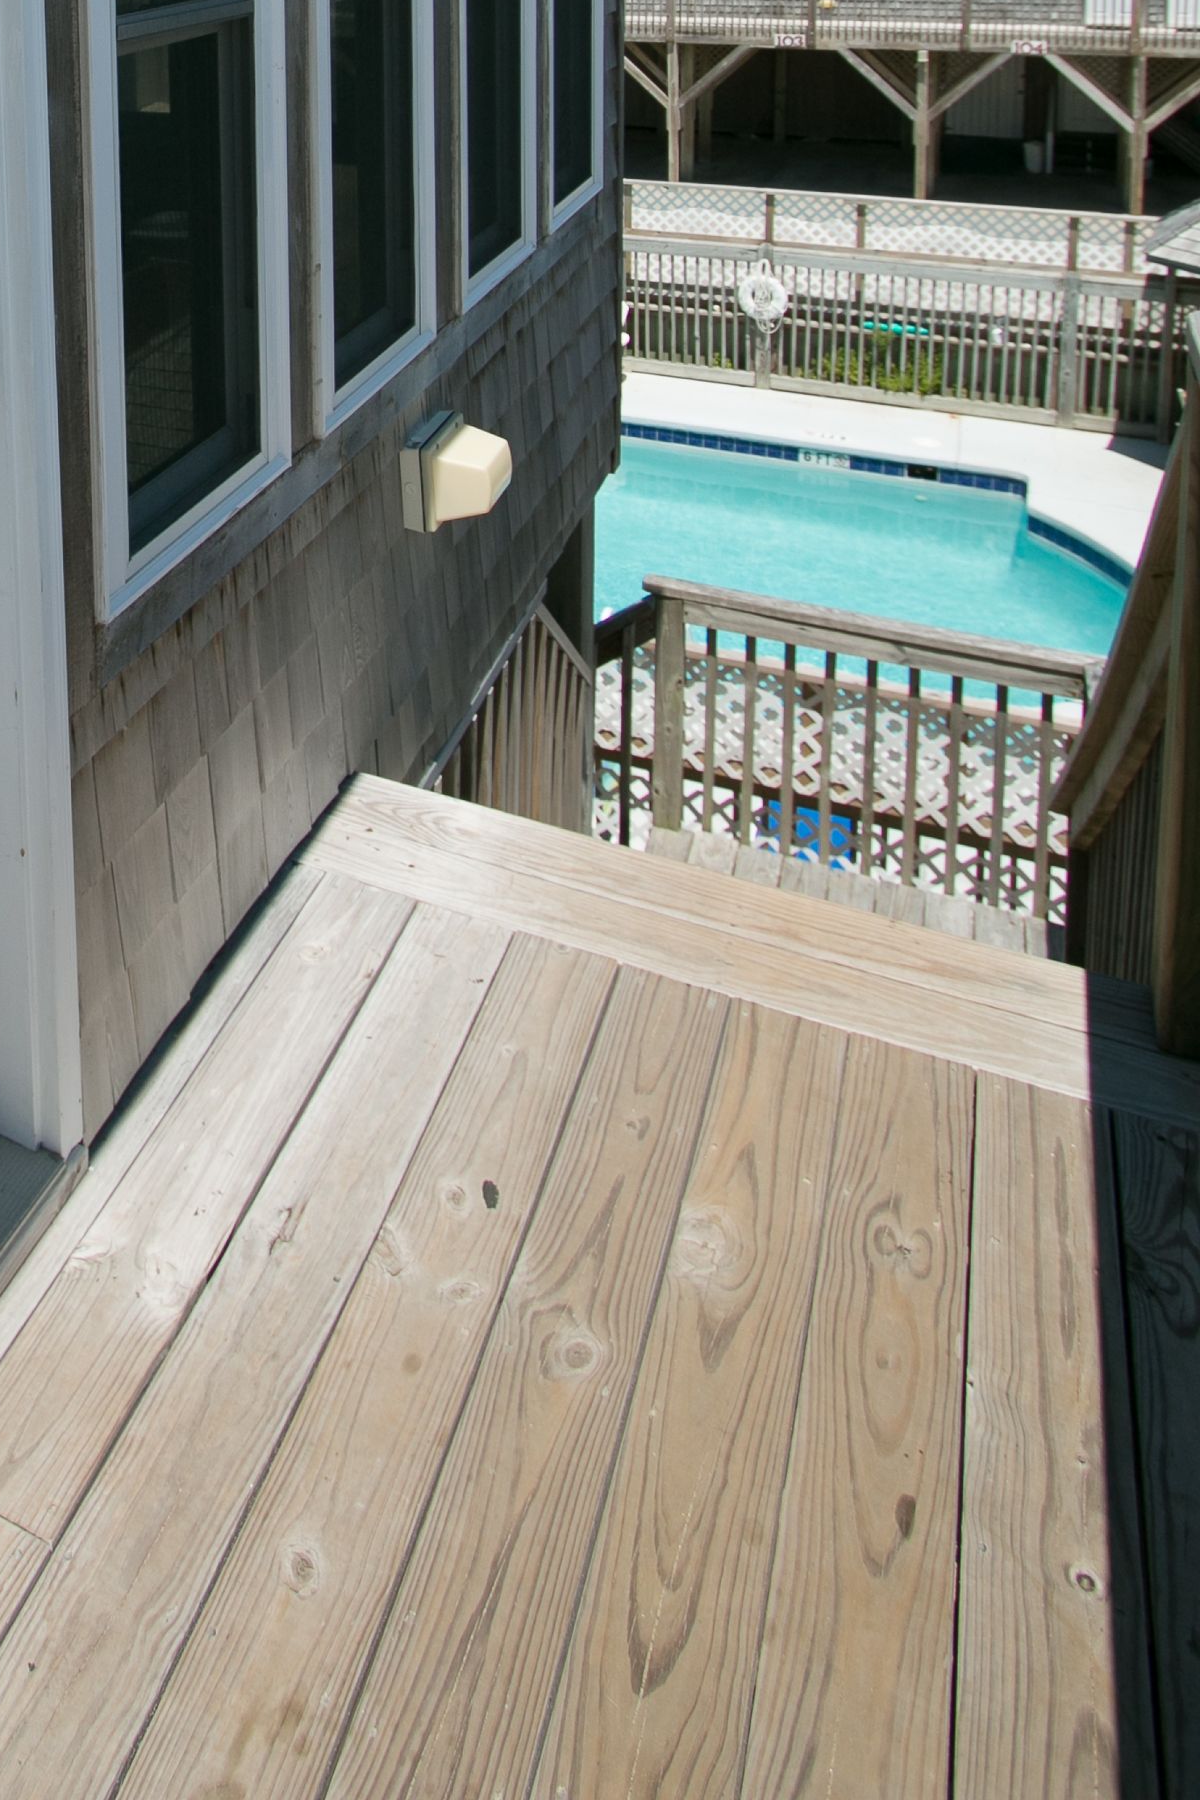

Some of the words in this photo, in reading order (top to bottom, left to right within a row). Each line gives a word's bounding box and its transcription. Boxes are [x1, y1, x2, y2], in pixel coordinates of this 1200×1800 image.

[777, 35, 803, 48] 103
[1015, 42, 1043, 55] 104
[803, 451, 812, 462] 6
[816, 452, 833, 466] FT
